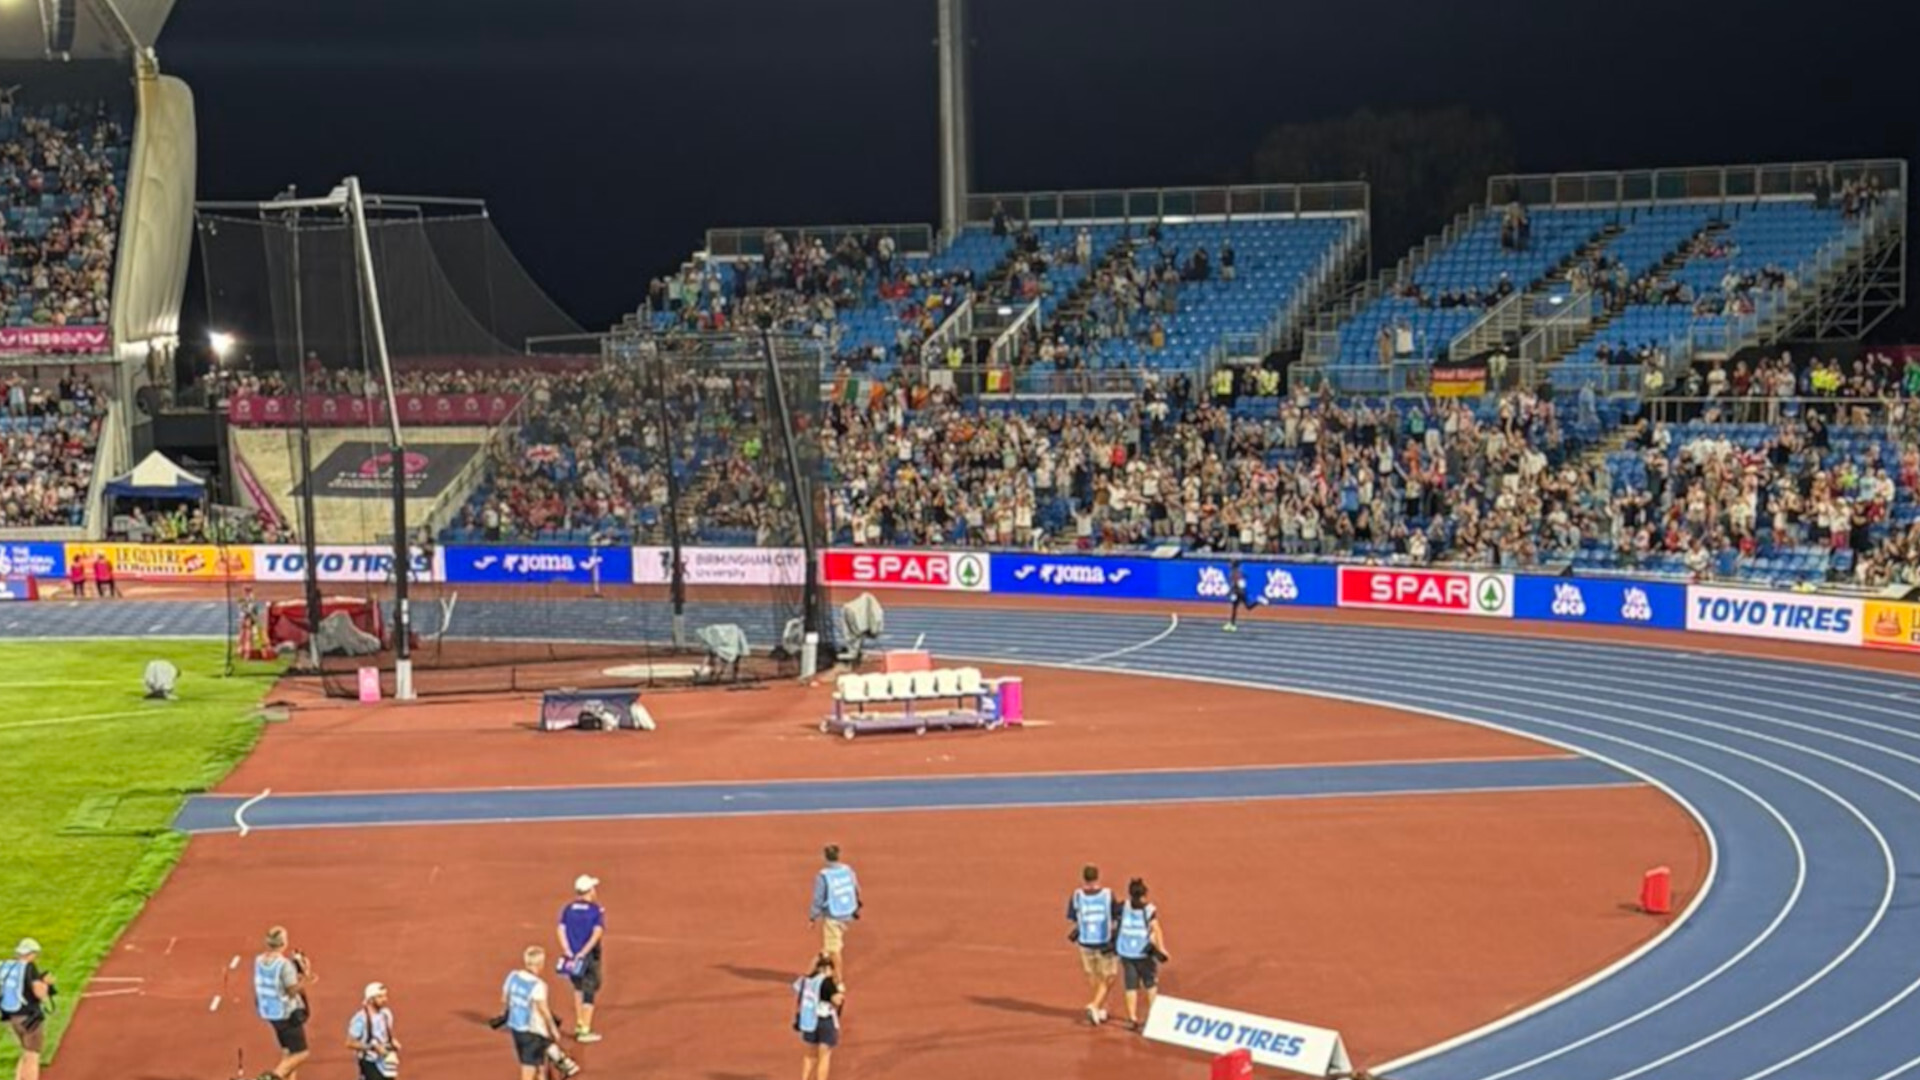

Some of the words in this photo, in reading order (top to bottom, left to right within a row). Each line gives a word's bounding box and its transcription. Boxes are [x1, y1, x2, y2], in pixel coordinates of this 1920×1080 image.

[349, 554, 430, 573] TIRS
[696, 553, 771, 566] BIRMINGHAM
[775, 554, 800, 567] CITY
[852, 555, 949, 582] SPAR
[1371, 574, 1468, 606] SPAR
[1698, 597, 1767, 625] TOYO
[1771, 603, 1853, 633] TIRES
[1174, 1012, 1234, 1042] TOYO
[1235, 1026, 1305, 1057] TIRES
